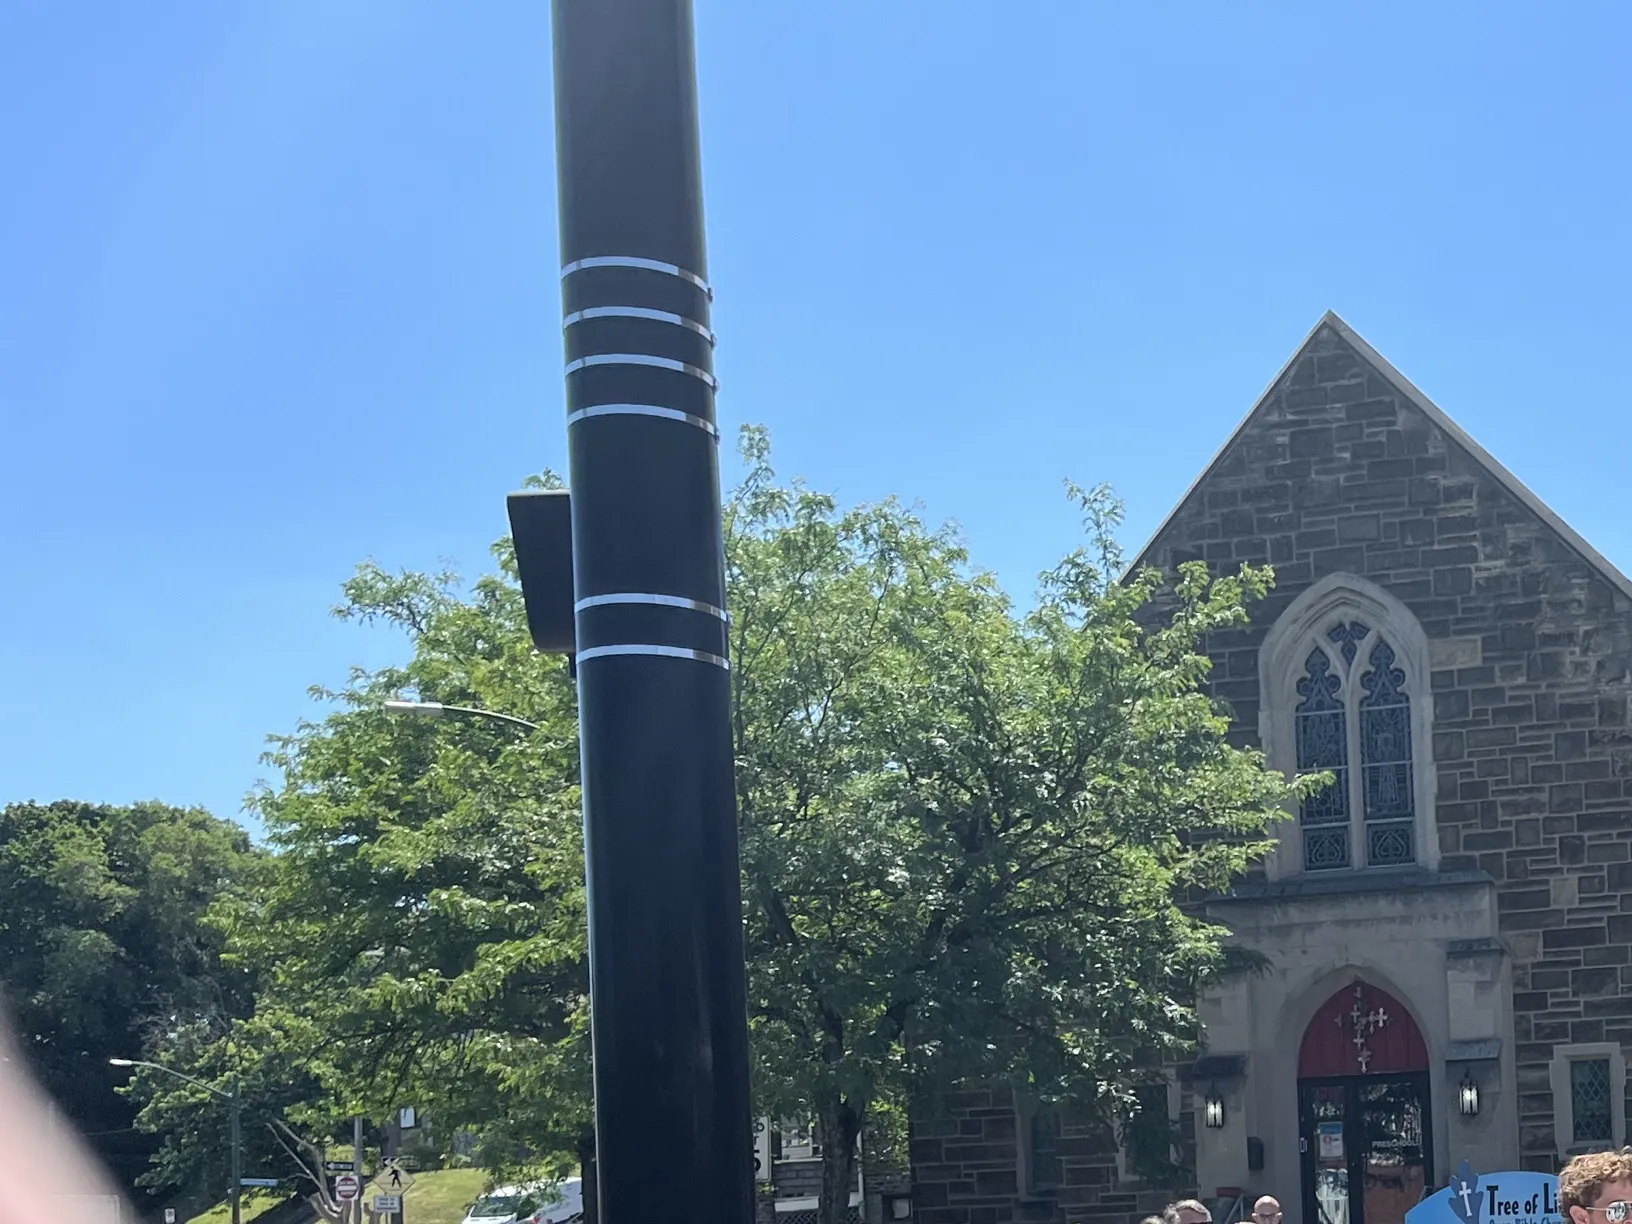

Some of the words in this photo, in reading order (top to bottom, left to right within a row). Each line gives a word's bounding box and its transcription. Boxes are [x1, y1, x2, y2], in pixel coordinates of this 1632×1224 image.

[1486, 1185, 1519, 1216] Tree
[1524, 1193, 1539, 1214] of
[1543, 1183, 1560, 1214] Li
